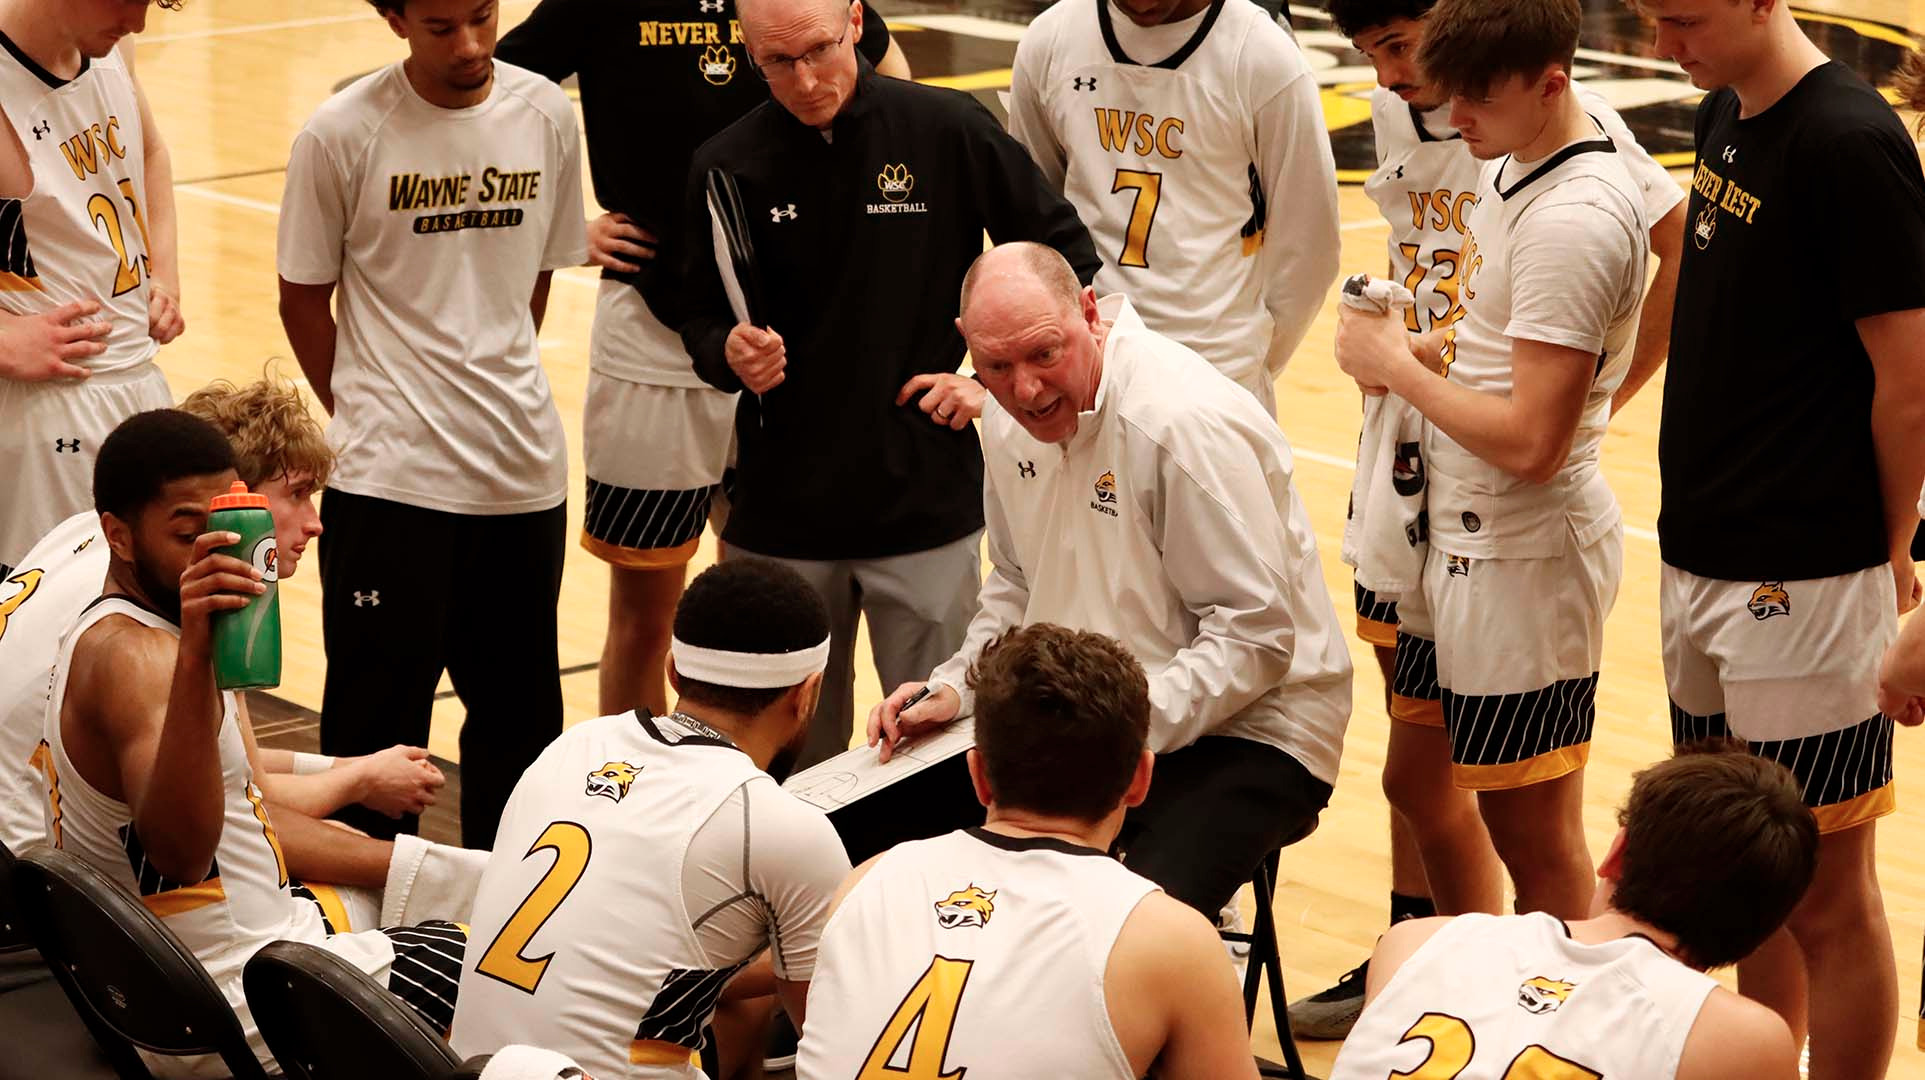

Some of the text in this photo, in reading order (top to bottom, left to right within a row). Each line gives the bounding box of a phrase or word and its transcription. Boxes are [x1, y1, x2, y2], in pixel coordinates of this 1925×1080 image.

[639, 20, 721, 46] NEVER
[59, 116, 126, 181] WSC
[1094, 107, 1185, 159] WSC
[389, 166, 541, 211] WAYNE STATE
[866, 202, 928, 214] BASKETBALL
[1110, 168, 1162, 268] 7
[1399, 242, 1461, 333] 13
[474, 821, 593, 996] 2
[854, 954, 975, 1080] 4
